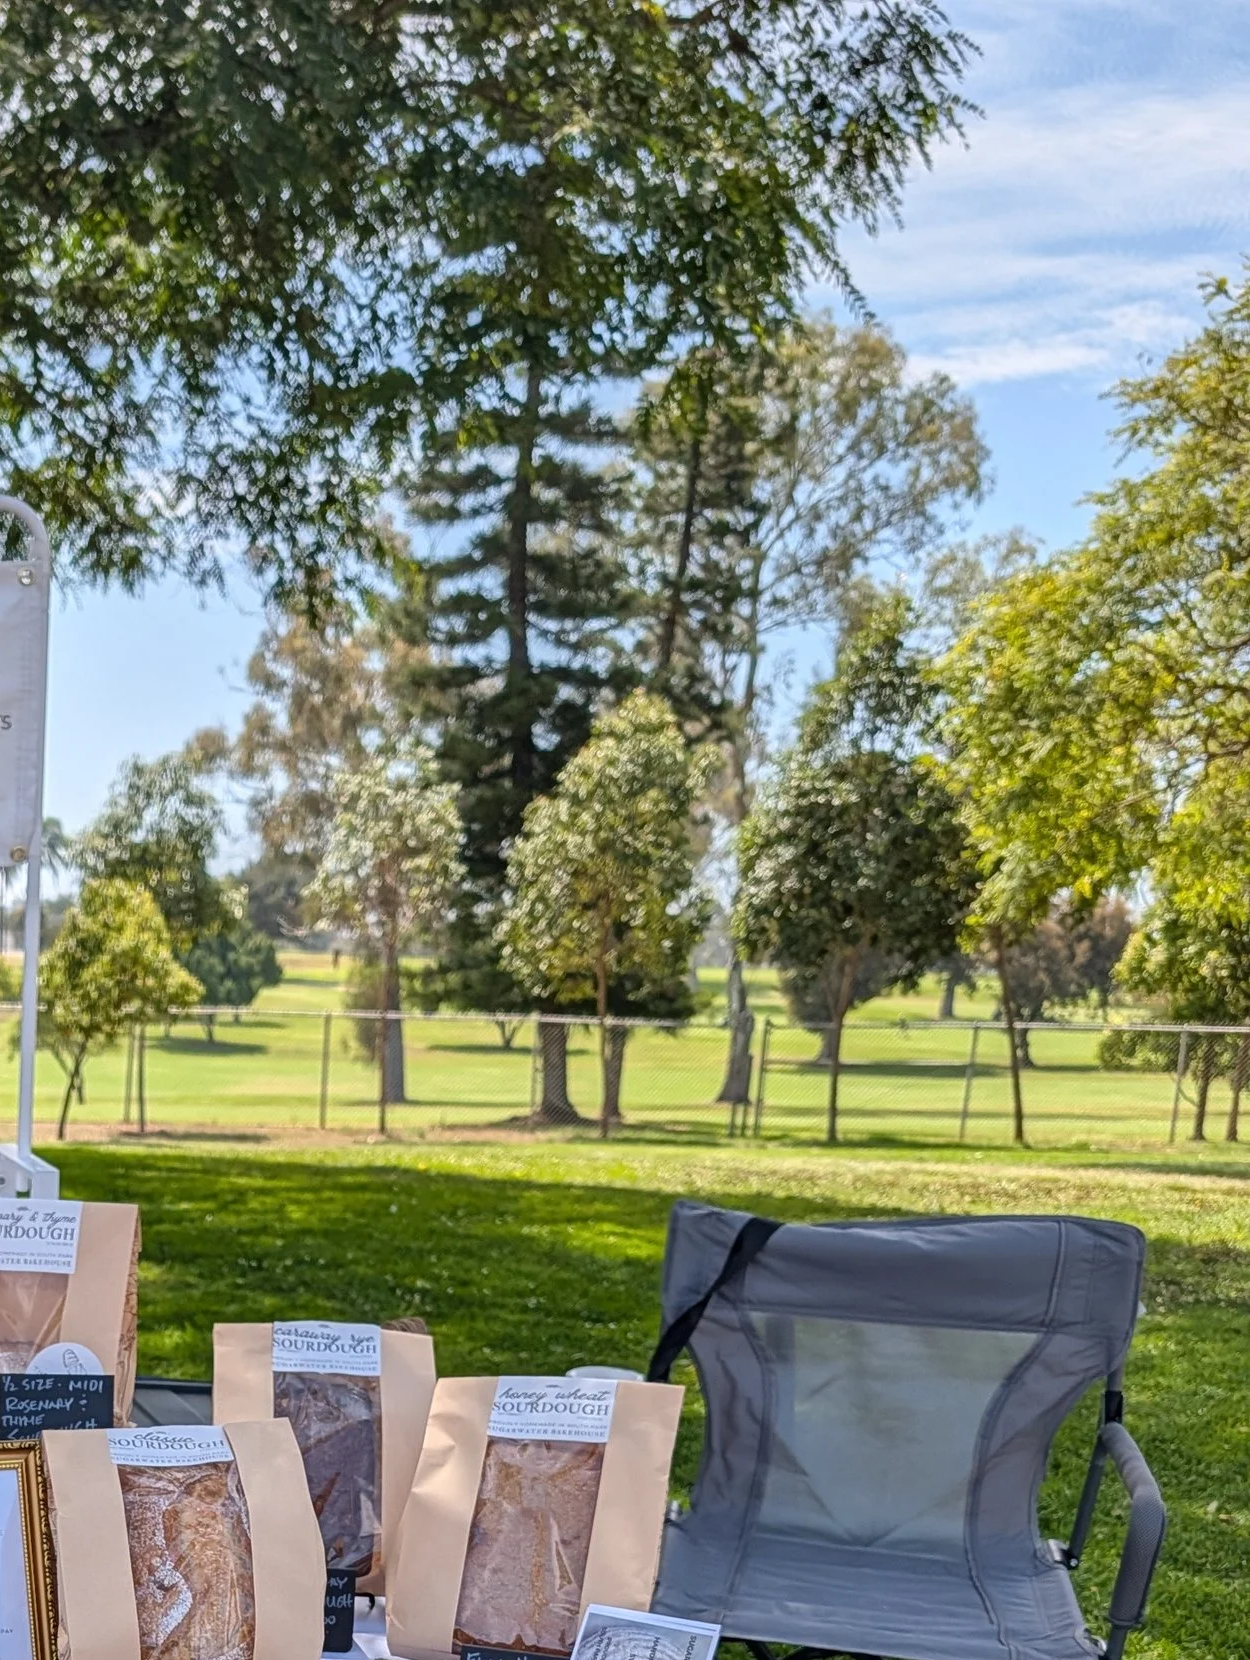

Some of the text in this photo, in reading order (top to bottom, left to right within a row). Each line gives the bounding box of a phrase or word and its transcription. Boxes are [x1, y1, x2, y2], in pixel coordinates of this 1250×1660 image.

[272, 1337, 377, 1354] SOURDOUGH
[274, 1327, 375, 1348] caraway rye
[2, 1376, 104, 1393] 1/2 SIZE MIDI
[498, 1387, 610, 1406] honey wheat
[492, 1401, 610, 1416] SOURDOUGH
[1, 1413, 46, 1427] THYME
[551, 1429, 606, 1437] BAKEHOUSE
[108, 1438, 225, 1451] SOURDOUGH
